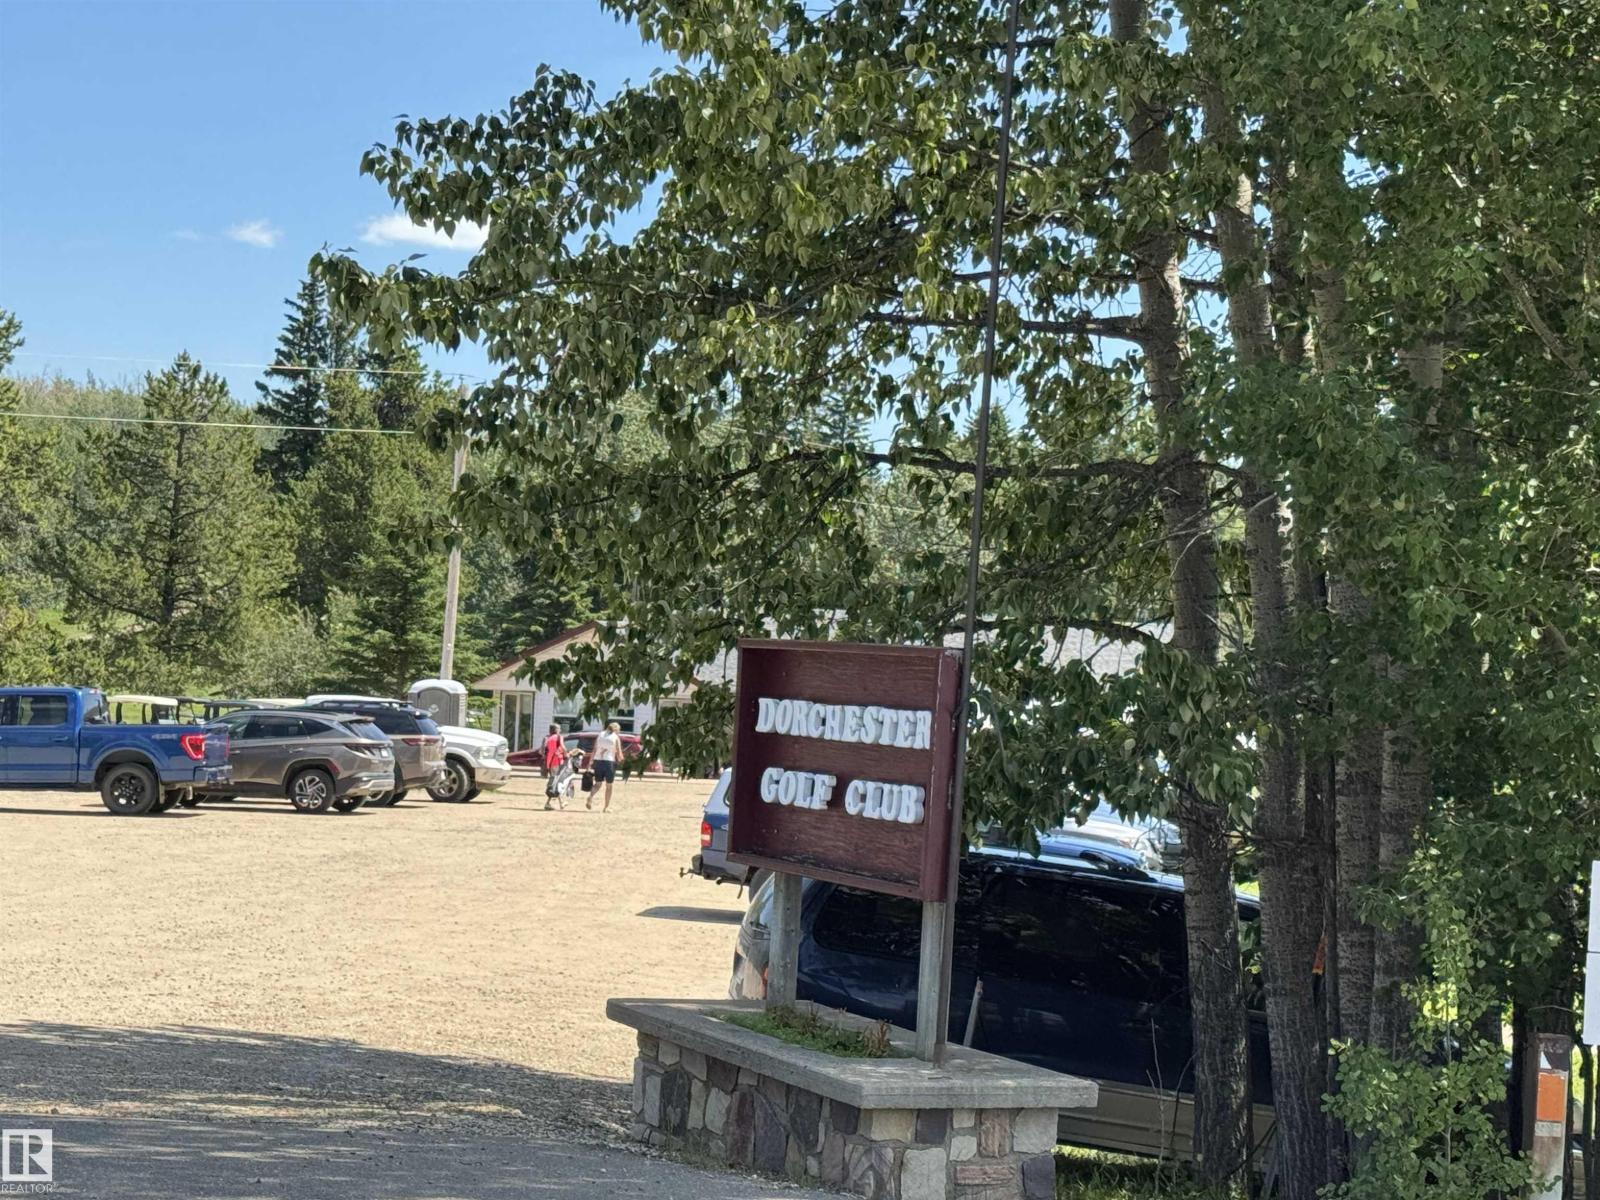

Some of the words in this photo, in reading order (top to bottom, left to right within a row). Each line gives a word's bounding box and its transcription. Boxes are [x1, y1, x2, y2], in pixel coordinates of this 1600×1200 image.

[755, 698, 932, 750] DORCHESTER
[760, 767, 837, 810] GOLF
[844, 779, 926, 824] CLUB
